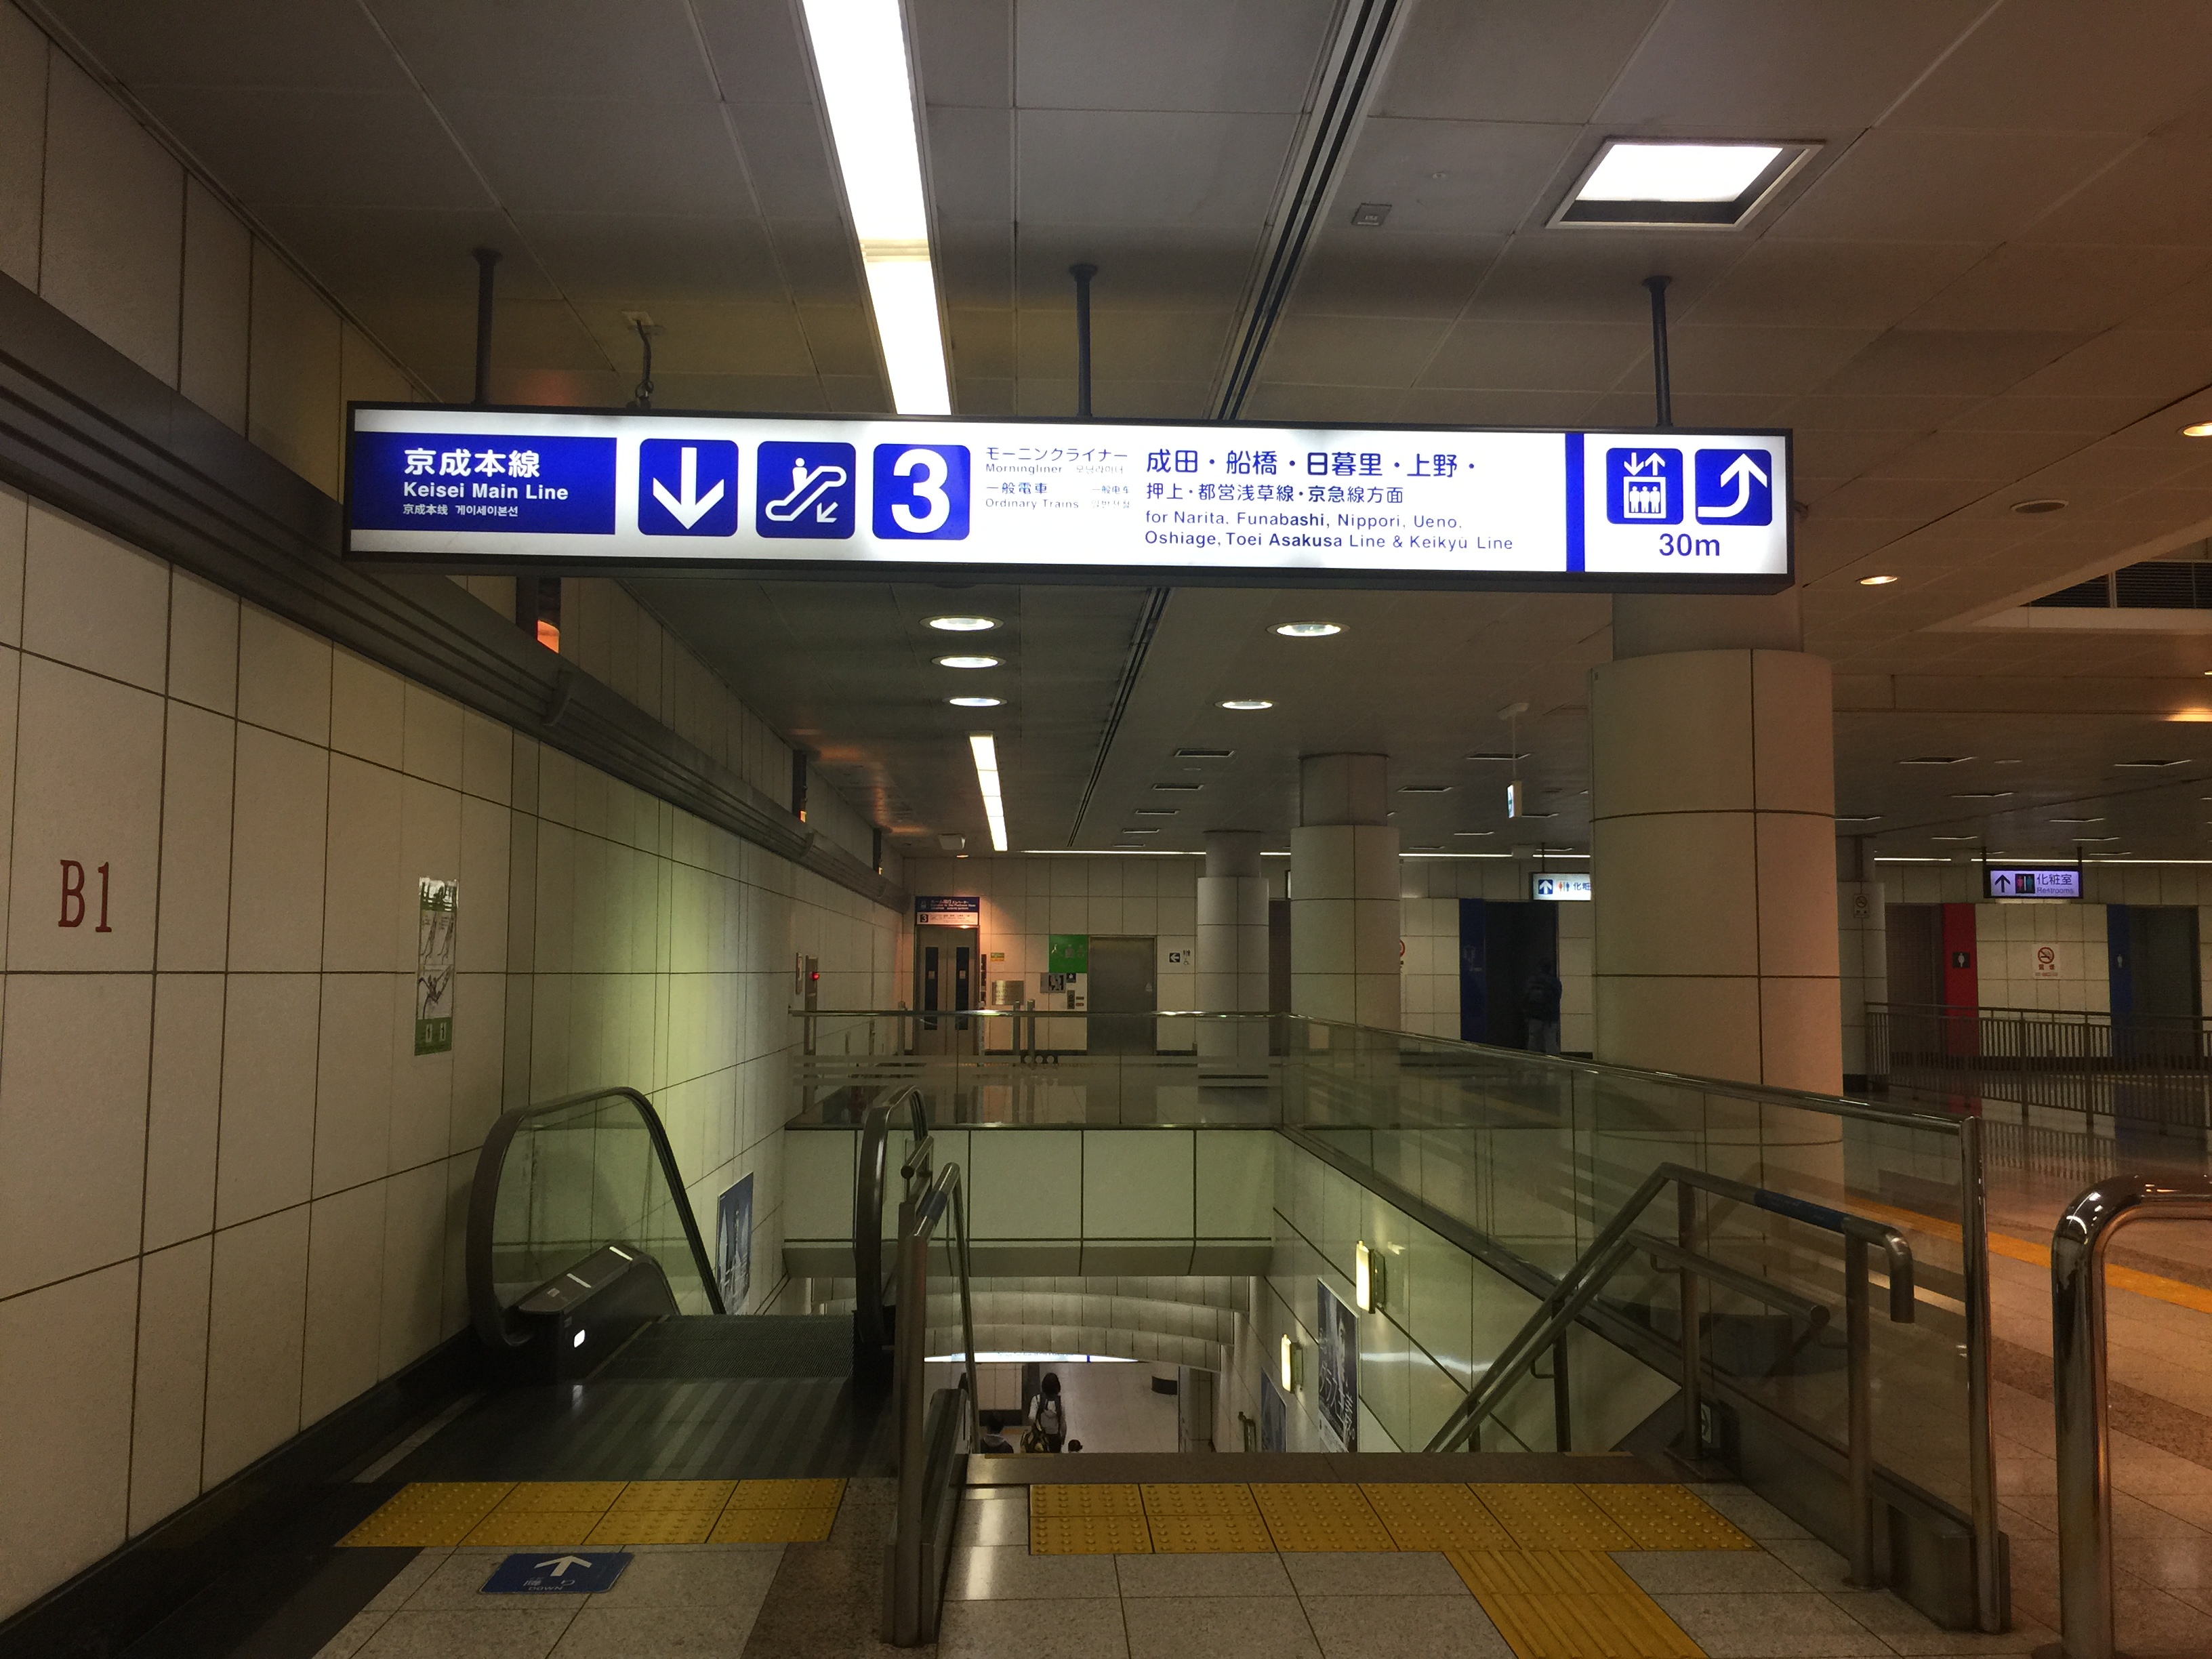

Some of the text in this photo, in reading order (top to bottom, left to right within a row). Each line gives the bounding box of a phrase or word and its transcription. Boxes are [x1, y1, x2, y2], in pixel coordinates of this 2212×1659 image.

[404, 447, 540, 478] 京成本線
[984, 463, 1064, 476] Morningliner
[404, 481, 569, 500] Keisei Main Line
[891, 448, 951, 533] 3
[986, 482, 1048, 495] 一般電車
[1146, 482, 1404, 504] 押上・都営浅草線・京急線方面
[403, 504, 449, 516] 京成本线
[985, 498, 1080, 510] Ordinary Trains
[1145, 510, 1168, 523] for
[1237, 512, 1330, 529] Funabashi,
[1338, 513, 1406, 531] Nippori,
[1145, 530, 1221, 549] Oshiage,
[1225, 532, 1262, 546] Toei
[1269, 533, 1343, 548] Asakusa
[1349, 534, 1386, 548] Line
[1392, 535, 1403, 548] &
[1477, 536, 1513, 550] Line
[1658, 533, 1720, 557] 30m
[2036, 873, 2072, 886] 化粧室
[58, 859, 112, 933] B1
[922, 914, 927, 922] 3
